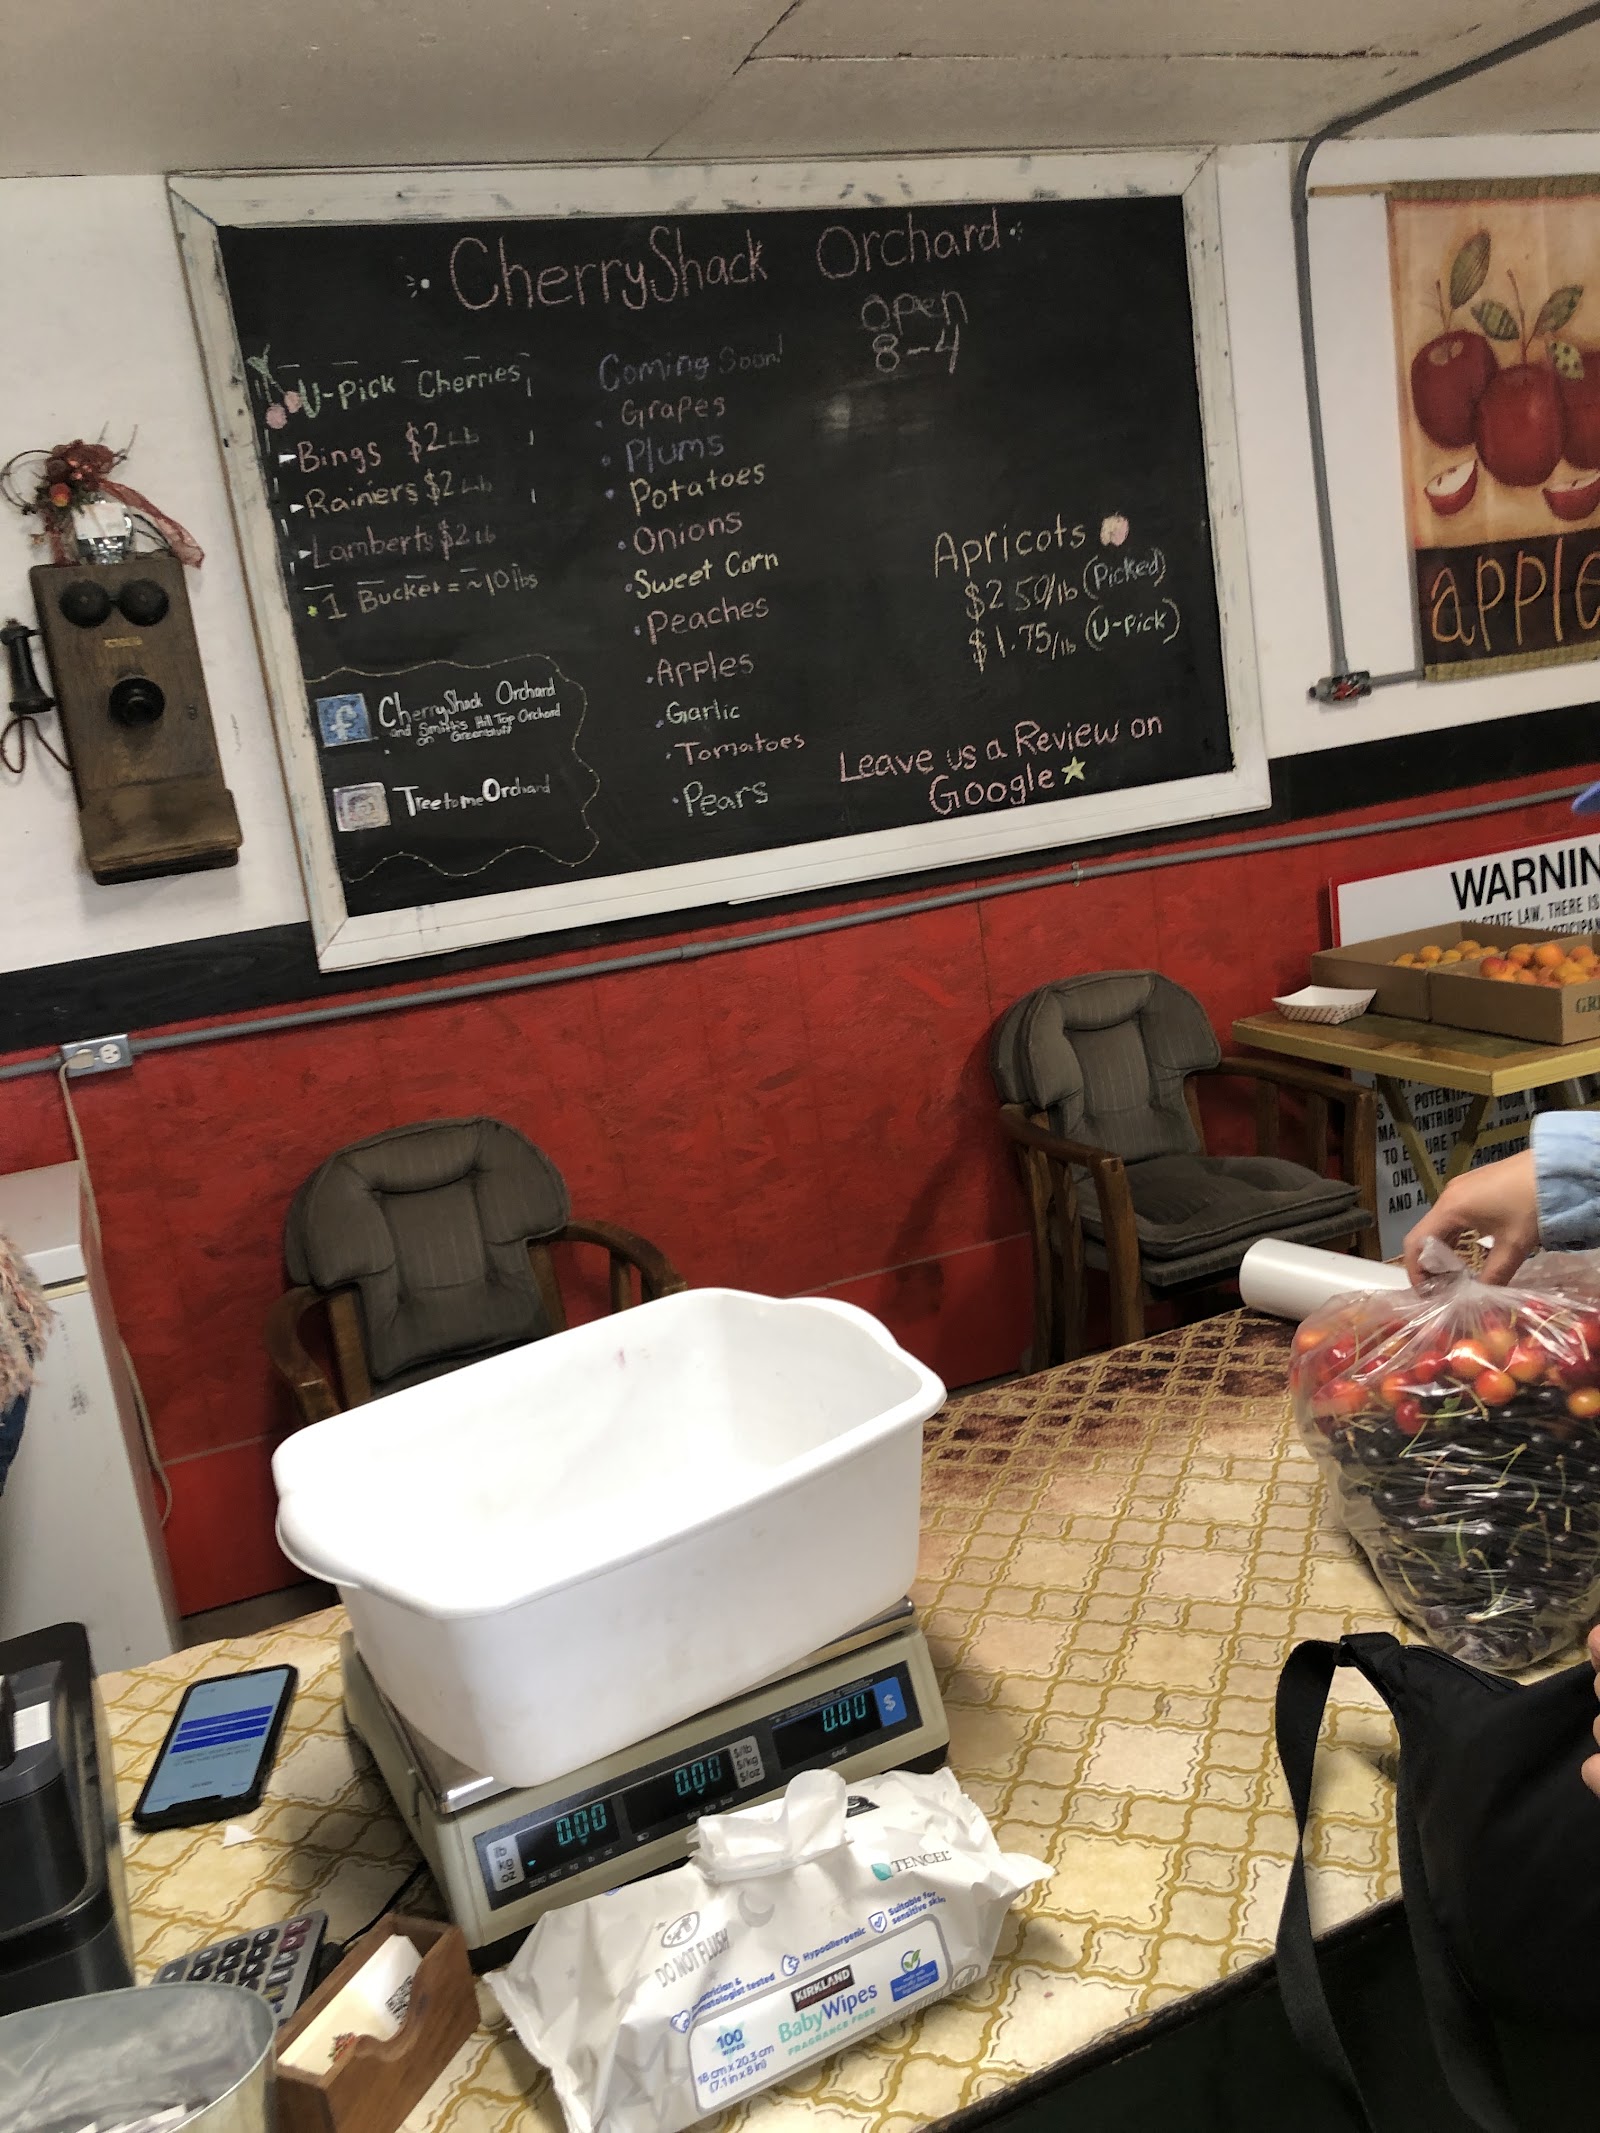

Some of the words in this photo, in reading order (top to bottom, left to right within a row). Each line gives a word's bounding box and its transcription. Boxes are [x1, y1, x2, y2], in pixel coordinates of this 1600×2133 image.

[817, 207, 1001, 279] Orchard
[418, 365, 520, 398] Cherries
[600, 352, 710, 392] Coming
[621, 395, 725, 429] Grapes
[297, 441, 382, 474] Bings
[625, 434, 725, 474] Plums
[305, 480, 418, 519] Rainiers
[629, 463, 766, 516] Potatoes
[312, 525, 434, 569] Lamberts
[633, 511, 743, 555] Onions
[933, 513, 1086, 578] Apricots
[634, 558, 713, 599] Sweet
[725, 550, 779, 578] Corn
[321, 593, 348, 620] 1
[357, 581, 441, 614] Bucket
[647, 597, 770, 646] Peaches
[656, 650, 755, 687] Apples
[495, 677, 556, 705] Orchard
[390, 724, 412, 738] and
[517, 702, 561, 723] Orchard
[666, 699, 741, 725] Garlic
[416, 735, 435, 747] on
[674, 732, 806, 766] Tomatoes
[839, 749, 934, 783] Leave
[946, 744, 977, 771] us
[985, 737, 1008, 762] a
[1013, 718, 1121, 759] Review
[1131, 715, 1164, 740] on
[682, 781, 770, 817] Pears
[928, 762, 1055, 816] Google
[1450, 845, 1600, 911] WARNIN
[1547, 897, 1583, 918] THERE
[1378, 1123, 1401, 1142] MA
[1383, 1147, 1398, 1166] TO
[1392, 1168, 1419, 1187] ONL
[1388, 1193, 1412, 1214] AND
[822, 1693, 866, 1733] 0.00
[883, 1693, 897, 1711] $
[674, 1755, 722, 1796] 0.00
[736, 1756, 758, 1771] $/kg
[556, 1803, 607, 1846] 0.00
[888, 1894, 921, 1916] Suitable
[923, 1889, 937, 1899] for
[892, 1903, 927, 1925] sensitive
[928, 1896, 946, 1907] skin
[655, 1962, 676, 1988] DO
[673, 1948, 700, 1978] NOT
[698, 1927, 731, 1964] FLUSH
[803, 1926, 866, 1961] Hypoallergenic
[745, 1972, 775, 1992] tested
[794, 1968, 851, 2003] KIRKLAND
[716, 2028, 744, 2050] 100
[788, 2019, 849, 2056] FRAGRANCE
[852, 2006, 877, 2025] FREE
[698, 2071, 710, 2085] 18
[711, 2066, 728, 2079] cm
[759, 2044, 775, 2057] cm
[722, 2043, 746, 2056] WIPES
